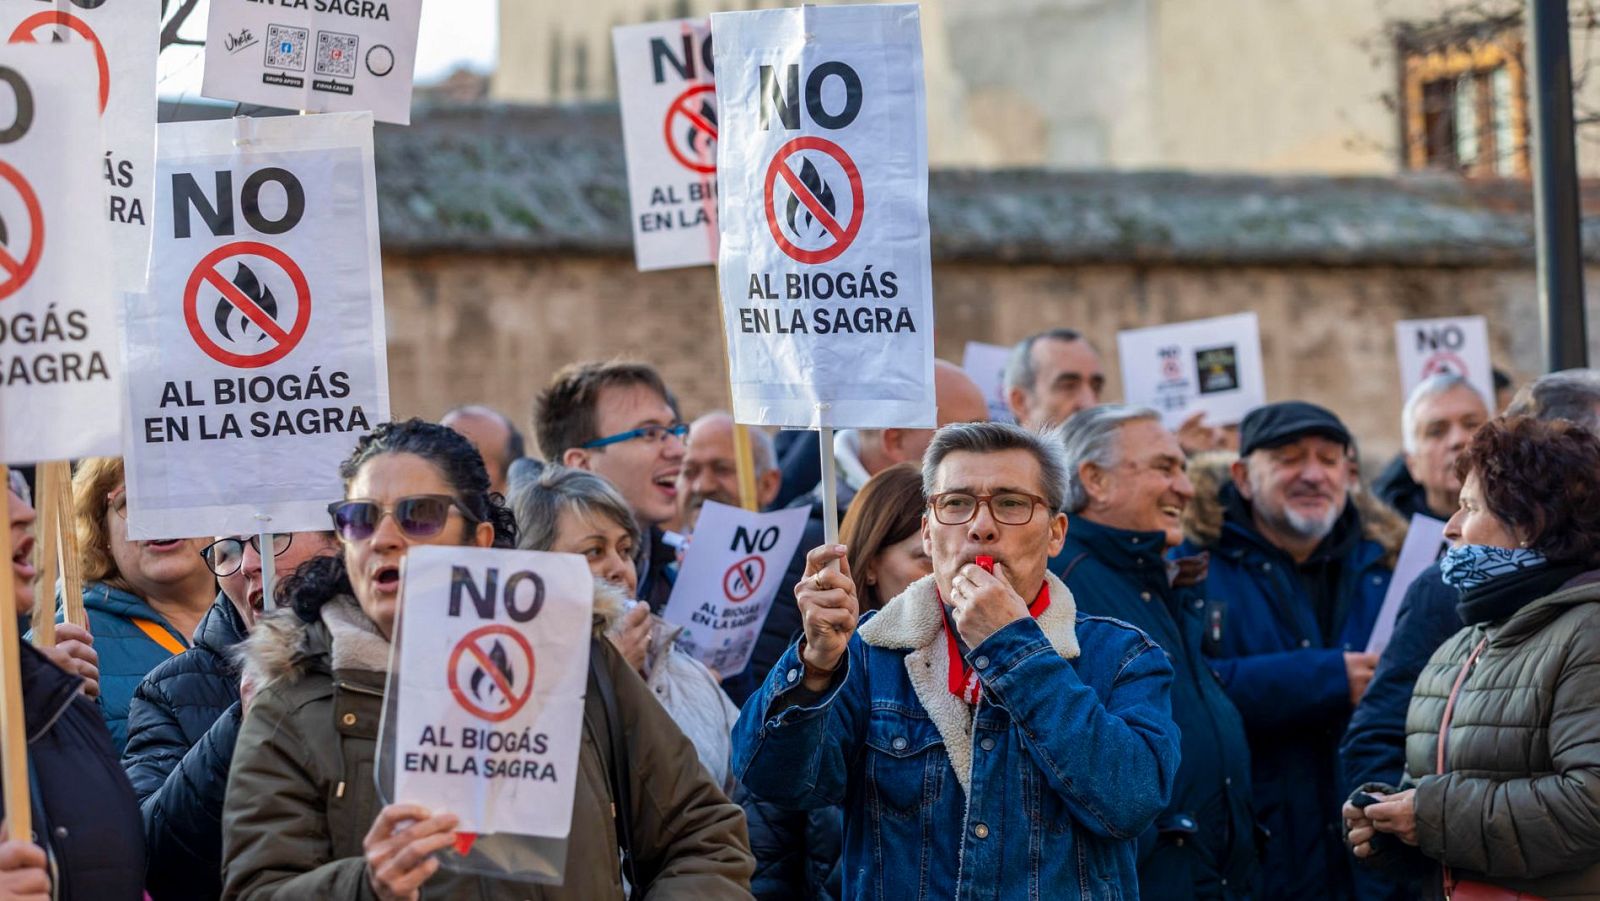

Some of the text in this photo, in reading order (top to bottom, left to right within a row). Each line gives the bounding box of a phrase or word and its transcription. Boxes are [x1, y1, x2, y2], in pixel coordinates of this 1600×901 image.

[314, 0, 390, 21] SAGRA
[760, 61, 863, 130] NO
[172, 168, 305, 238] NO
[650, 184, 683, 207] AL
[640, 211, 672, 232] EN
[679, 206, 712, 228] LA
[748, 265, 898, 300] AL BIOGÁS
[740, 307, 916, 334] EN LA SAGRA
[1416, 325, 1464, 354] NO
[0, 350, 110, 386] AGRA
[160, 366, 350, 408] AL BIOGÁS
[145, 405, 371, 443] EN LA SAGRA
[730, 525, 780, 554] NO
[448, 566, 545, 623] NO
[691, 611, 711, 626] EN
[712, 619, 728, 630] LA
[700, 602, 718, 617] AL
[419, 726, 548, 754] AL BIOGÁS
[405, 753, 557, 782] EN LA SAGRA
